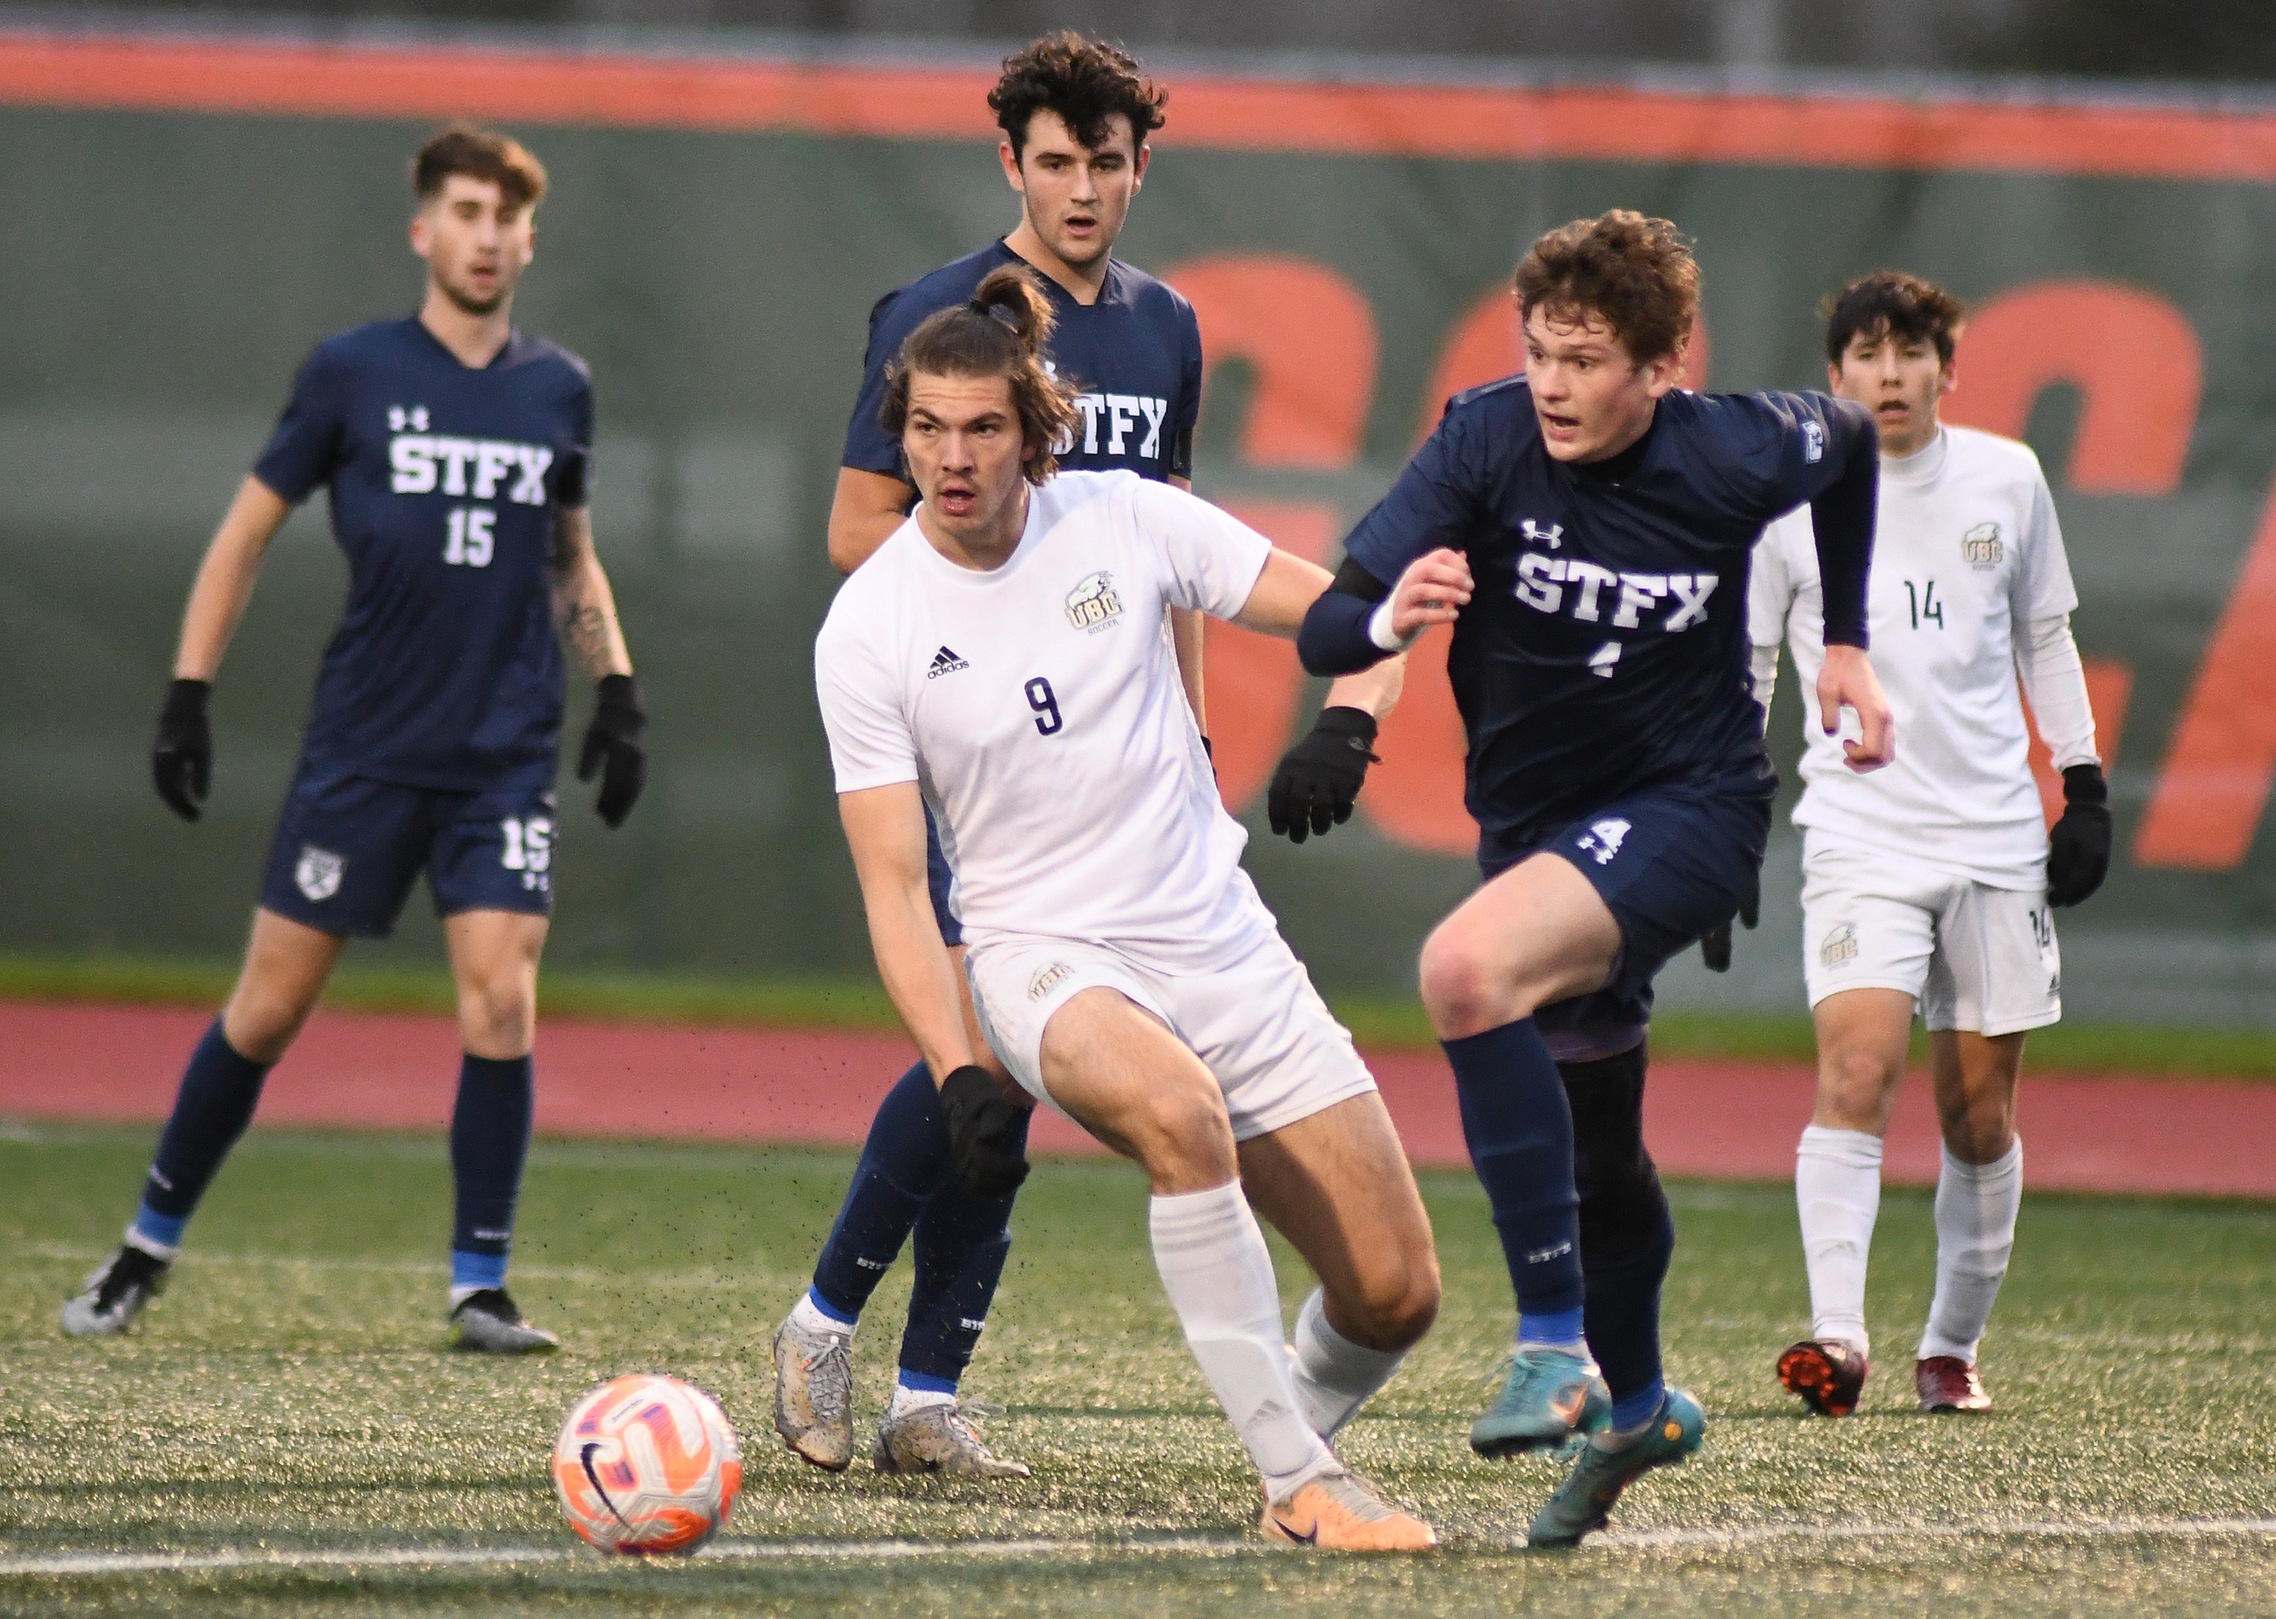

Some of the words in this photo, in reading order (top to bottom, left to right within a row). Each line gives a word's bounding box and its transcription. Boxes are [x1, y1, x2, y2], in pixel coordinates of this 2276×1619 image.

[389, 435, 554, 506] STFX
[444, 508, 497, 567] 15
[1064, 589, 1124, 631] UBC
[1514, 551, 1720, 633] STFX
[1903, 580, 1944, 630] 14
[1087, 618, 1119, 636] SOCCER
[927, 660, 970, 680] adidas
[1023, 676, 1064, 737] 9
[502, 815, 550, 872] 15
[1591, 817, 1632, 855] 4
